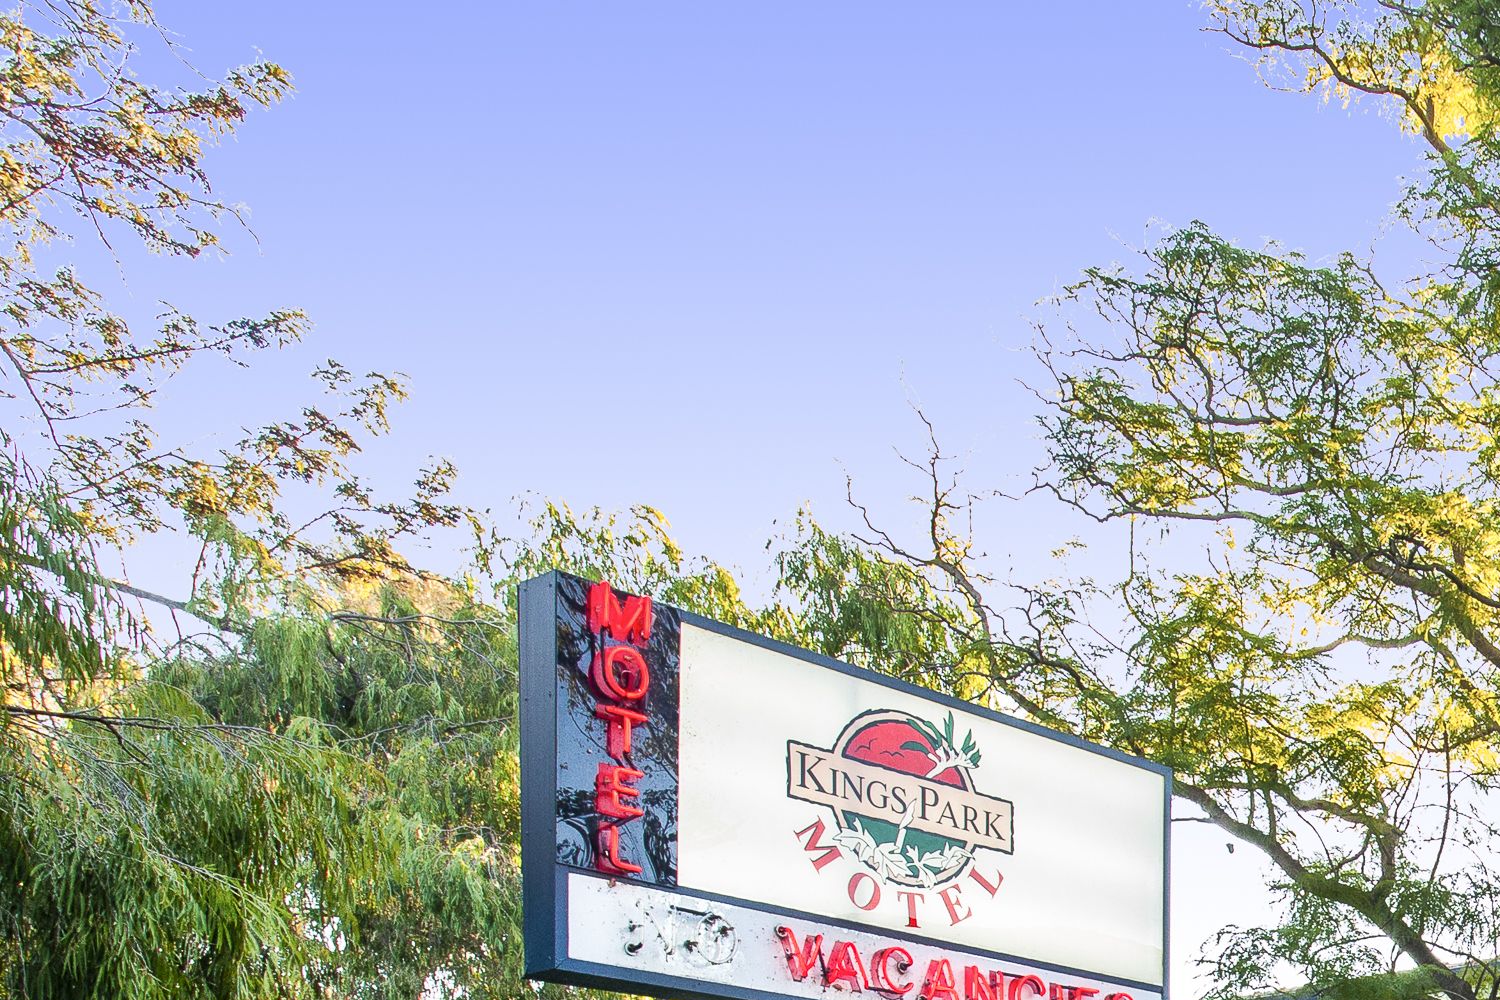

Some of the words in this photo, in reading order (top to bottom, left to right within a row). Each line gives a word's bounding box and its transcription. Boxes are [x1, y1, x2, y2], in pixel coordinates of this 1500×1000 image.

[586, 580, 653, 874] MOTEL
[796, 751, 909, 814] KINGS
[917, 785, 1006, 841] PARK
[793, 815, 1005, 929] MOTEL
